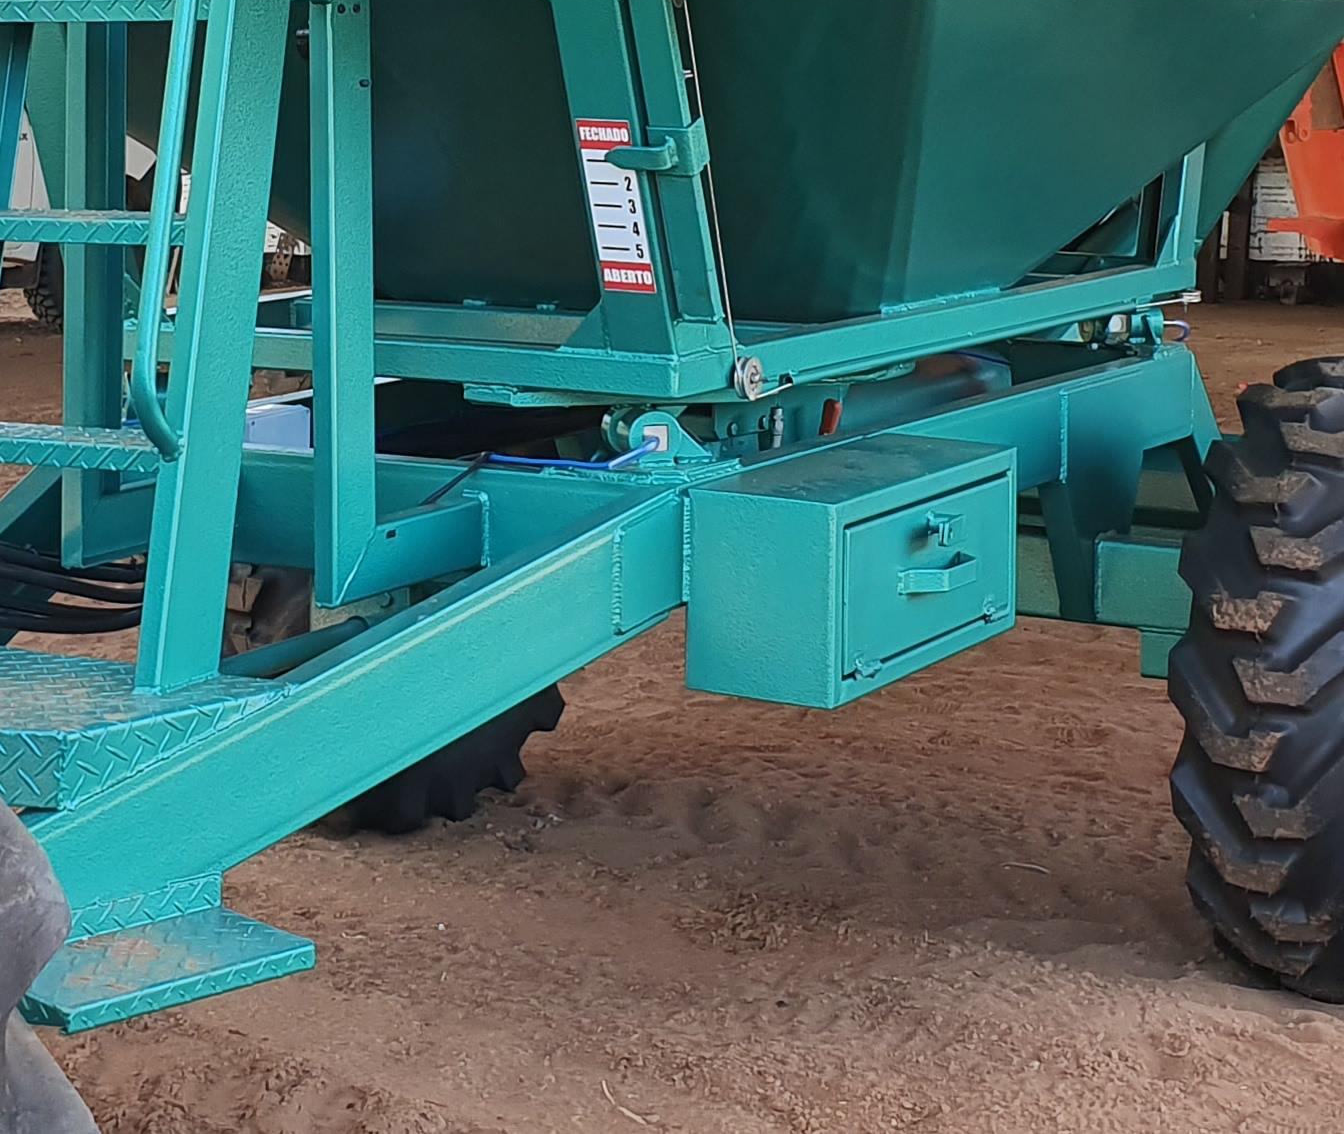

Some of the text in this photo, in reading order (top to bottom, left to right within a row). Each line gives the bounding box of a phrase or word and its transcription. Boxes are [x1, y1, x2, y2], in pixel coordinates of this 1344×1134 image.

[580, 126, 629, 142] FECHADO
[624, 176, 632, 191] 2
[628, 199, 636, 214] 3
[633, 221, 640, 236] 4
[636, 244, 644, 259] 5
[604, 268, 652, 284] ABERTO
